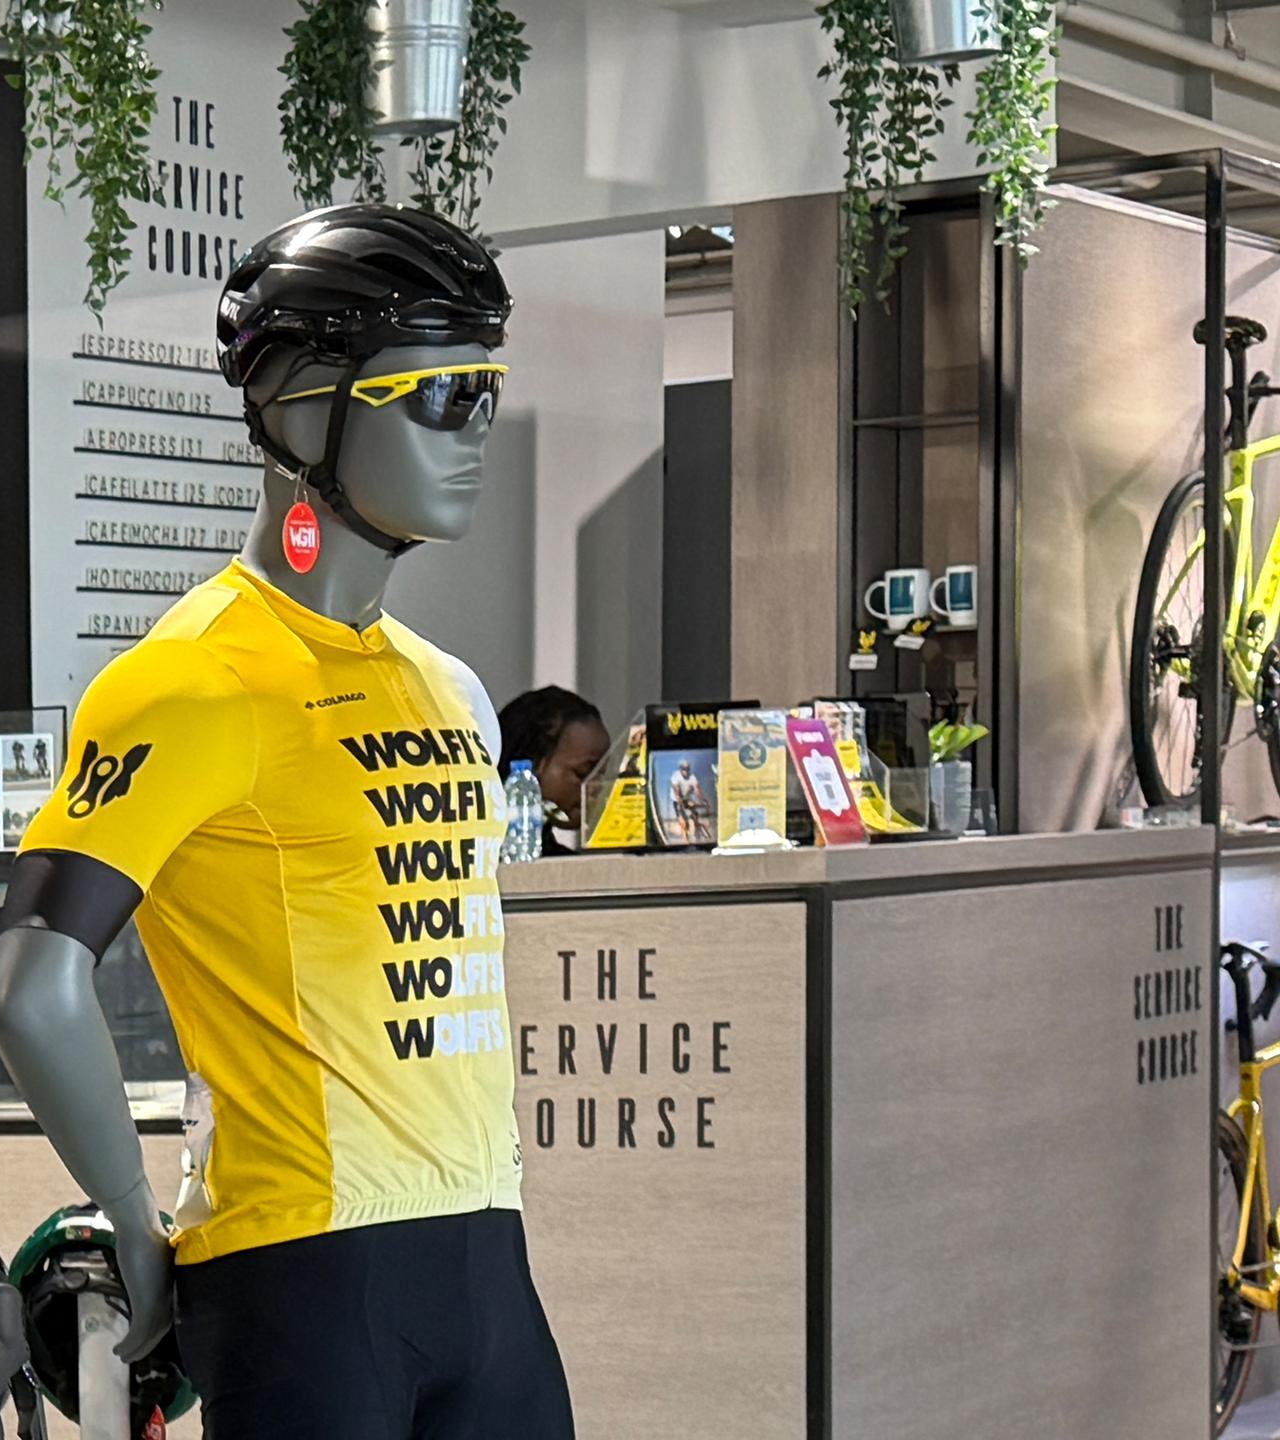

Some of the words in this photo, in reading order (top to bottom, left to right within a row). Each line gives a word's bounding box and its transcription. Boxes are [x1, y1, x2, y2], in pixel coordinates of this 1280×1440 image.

[173, 96, 215, 150] THE
[89, 335, 167, 363] ESPRESSO
[87, 380, 186, 412] CAPPUCCINO
[88, 428, 176, 455] AEROPRESS
[91, 568, 118, 588] HOT
[316, 691, 367, 709] COLNAGO
[339, 728, 492, 772] WOLFI'S
[557, 948, 657, 1001] THE
[1134, 965, 1202, 1020] SERVICE
[520, 1021, 732, 1076] ERVICE
[1137, 1029, 1198, 1086] COURSE
[536, 1096, 718, 1151] OURSE
